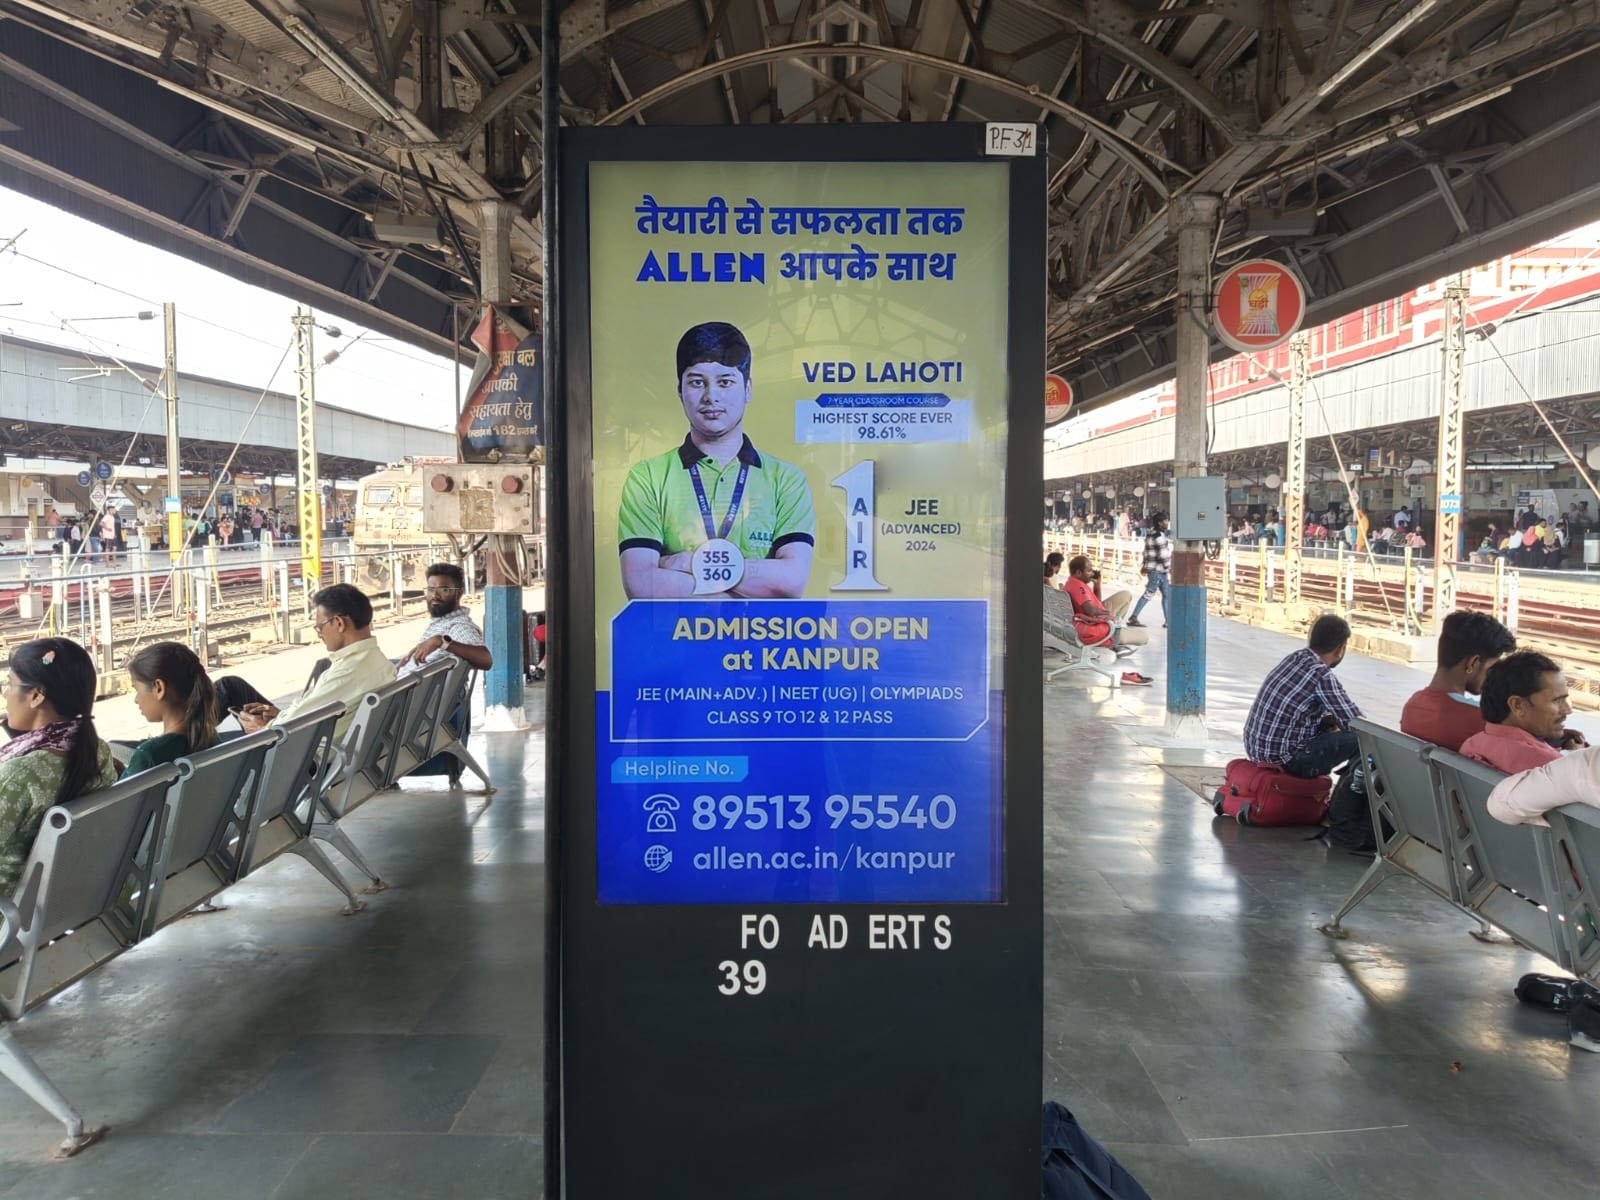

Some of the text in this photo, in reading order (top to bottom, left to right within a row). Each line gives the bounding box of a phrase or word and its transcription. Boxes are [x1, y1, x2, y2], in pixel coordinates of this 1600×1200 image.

[635, 194, 965, 235] तैयारी से सफलता तक
[635, 244, 956, 285] ALLEN आपके साथ
[803, 362, 963, 383] VED LAHOTI
[855, 396, 905, 406] CLASSROOM
[906, 396, 939, 406] COURSE
[813, 412, 953, 424] HIGHEST SCORE EVER
[858, 426, 906, 439] 98.61%
[905, 499, 939, 515] JEE
[881, 522, 961, 536] (ADVANCED)
[905, 540, 937, 551] 2024
[702, 551, 730, 563] 355
[702, 568, 732, 581] 360
[672, 616, 928, 640] ADMISSION OPEN
[722, 647, 880, 671] at KANPUR
[636, 687, 662, 701] JEE
[779, 687, 819, 700] NEET
[822, 686, 858, 703] (UG)
[870, 687, 964, 700] OLYMPIADS
[707, 711, 893, 724] CLASS 9 TO 12 & 12 PASS
[625, 760, 735, 779] Helpline No.
[691, 794, 957, 831] 89513 95540
[693, 843, 956, 874] allen.ac.in/kanpur
[717, 960, 767, 996] 39
